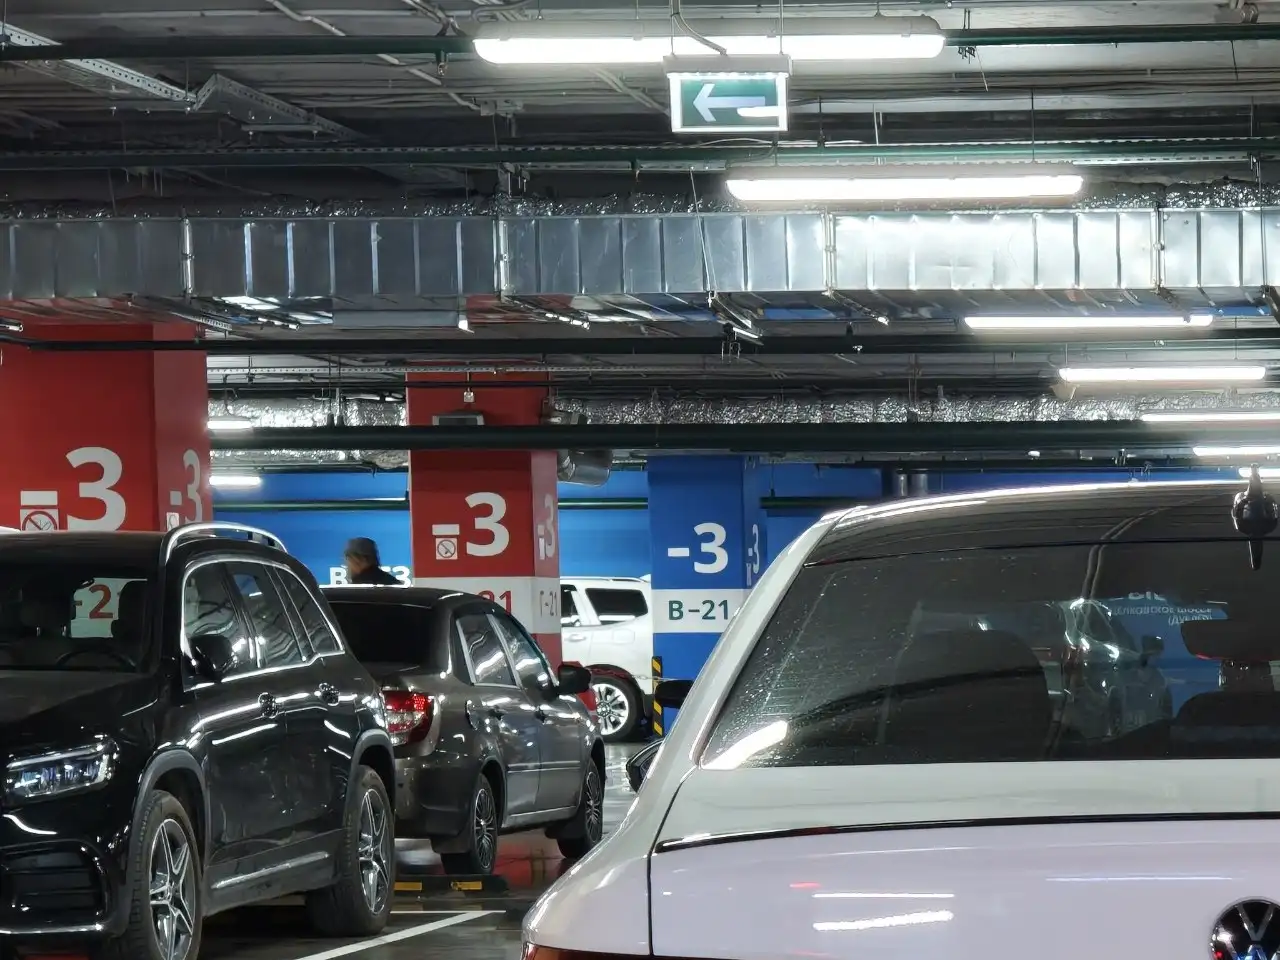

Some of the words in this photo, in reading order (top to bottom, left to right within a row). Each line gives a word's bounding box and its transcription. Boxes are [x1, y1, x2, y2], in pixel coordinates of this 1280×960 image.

[20, 446, 126, 531] -3
[432, 491, 510, 557] -3
[667, 522, 729, 574] -3
[668, 600, 729, 620] В-21
